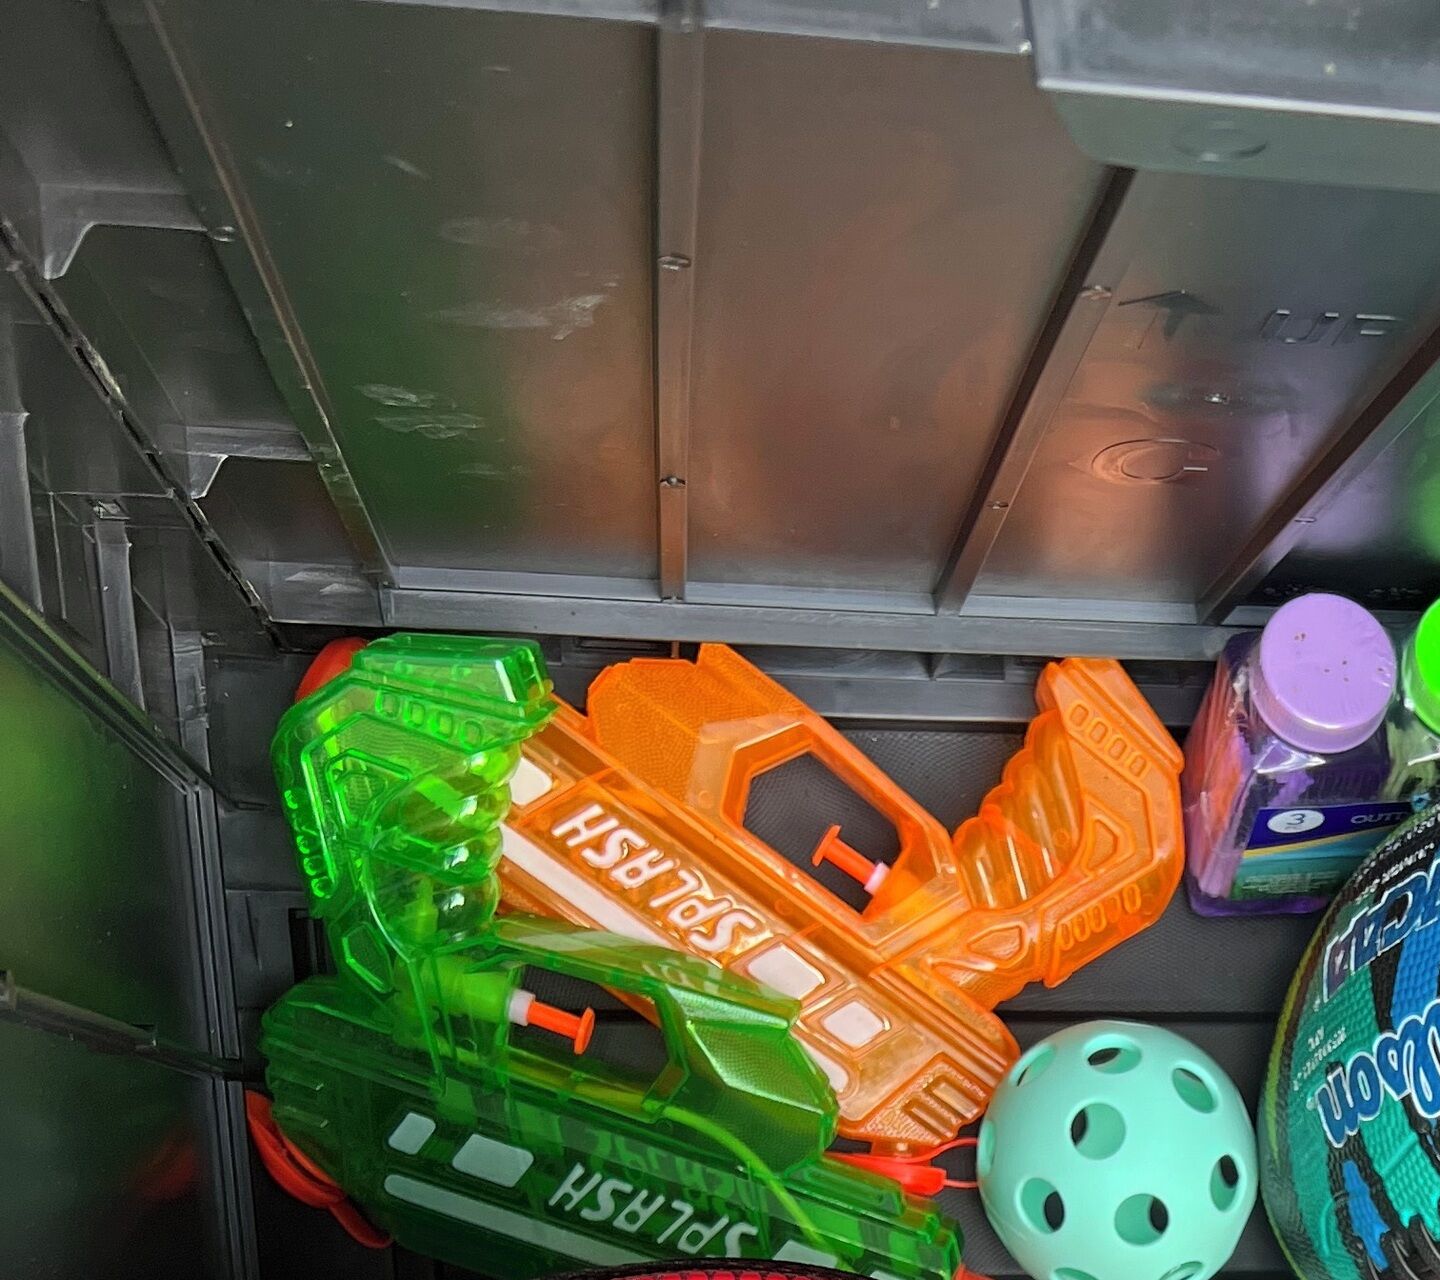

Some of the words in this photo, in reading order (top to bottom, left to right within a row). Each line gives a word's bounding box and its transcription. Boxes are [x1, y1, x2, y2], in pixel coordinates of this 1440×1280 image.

[1287, 812, 1306, 826] 3
[551, 804, 756, 956] SPLASH
[548, 1162, 758, 1259] SPLASH
